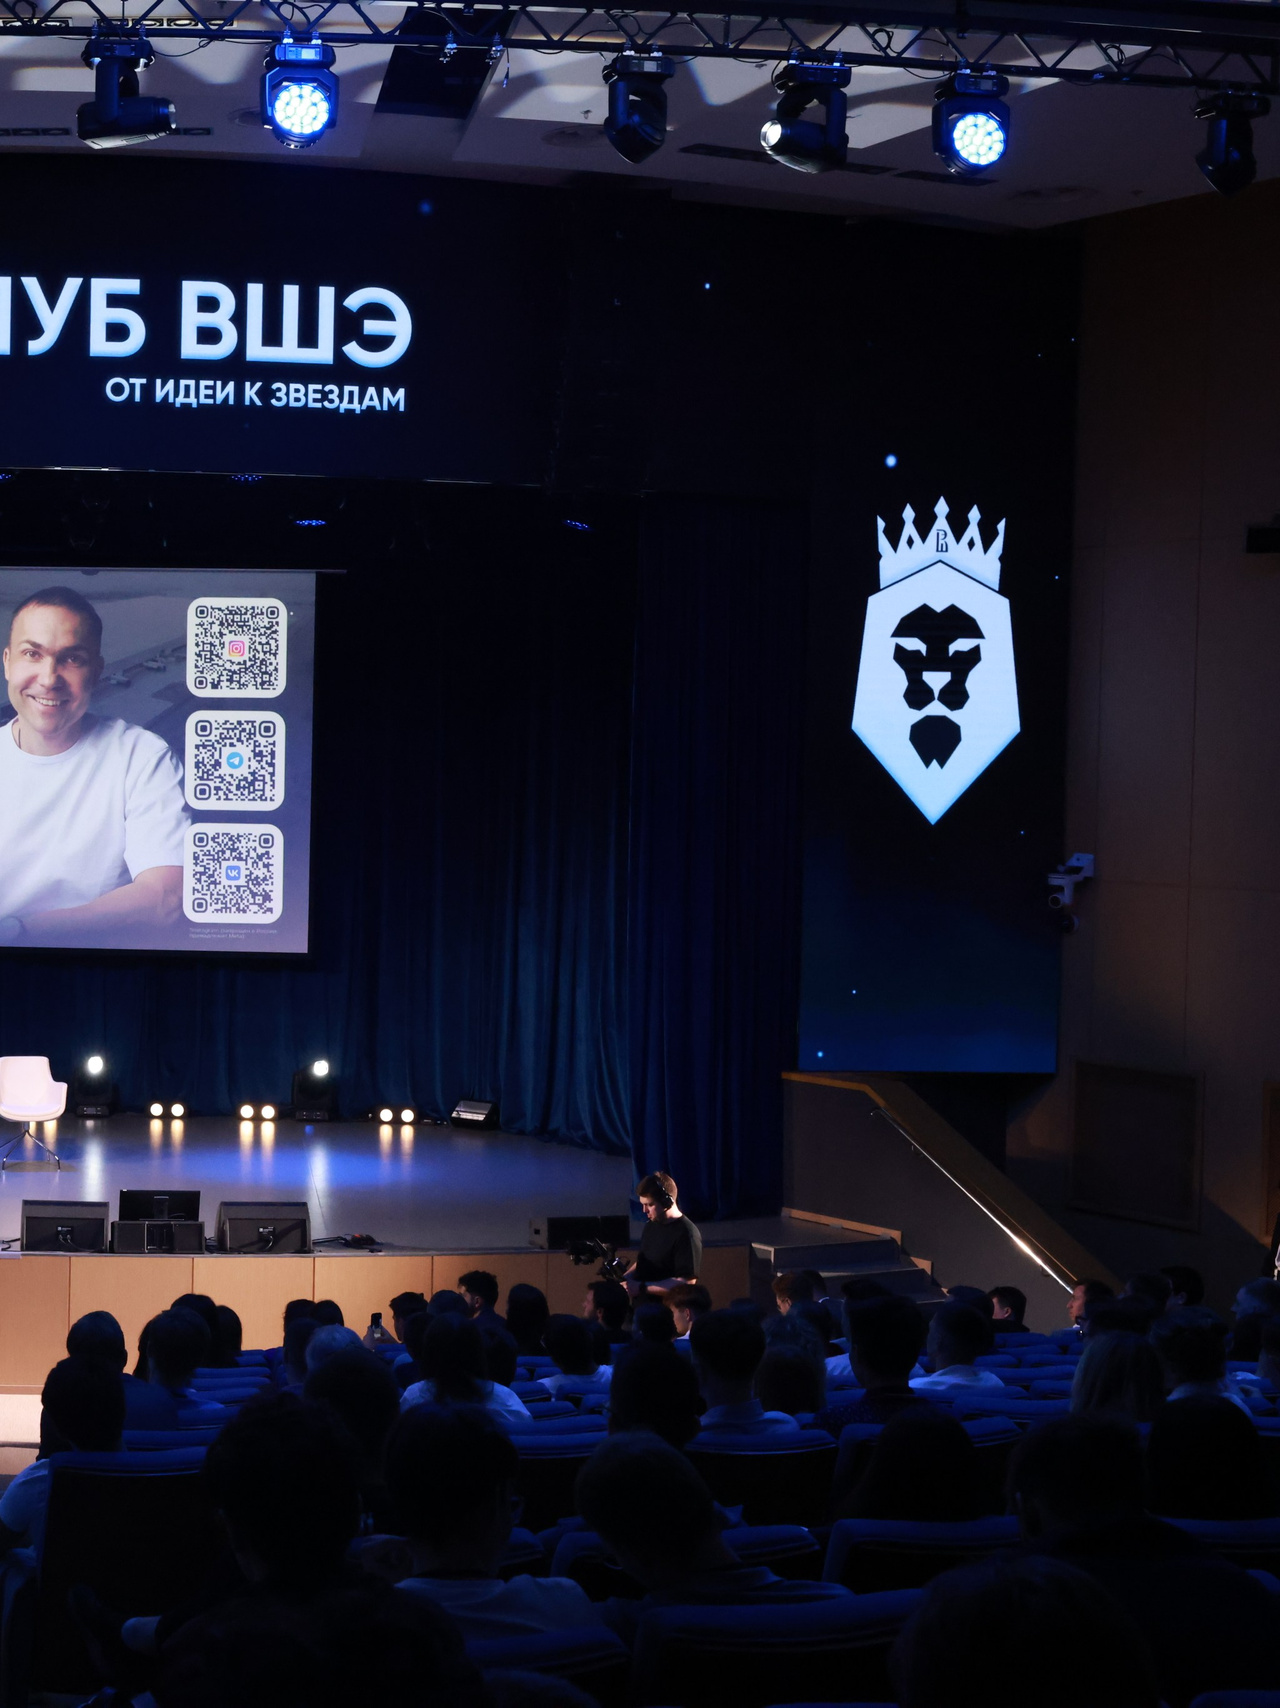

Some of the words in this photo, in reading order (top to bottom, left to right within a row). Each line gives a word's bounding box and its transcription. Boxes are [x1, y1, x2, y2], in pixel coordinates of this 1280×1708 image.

[181, 281, 412, 367] ВШЭ
[106, 378, 146, 401] ОТ
[156, 379, 234, 407] ИДЕИ
[245, 382, 262, 405] К
[271, 383, 404, 413] ЗВЕЗДАМ
